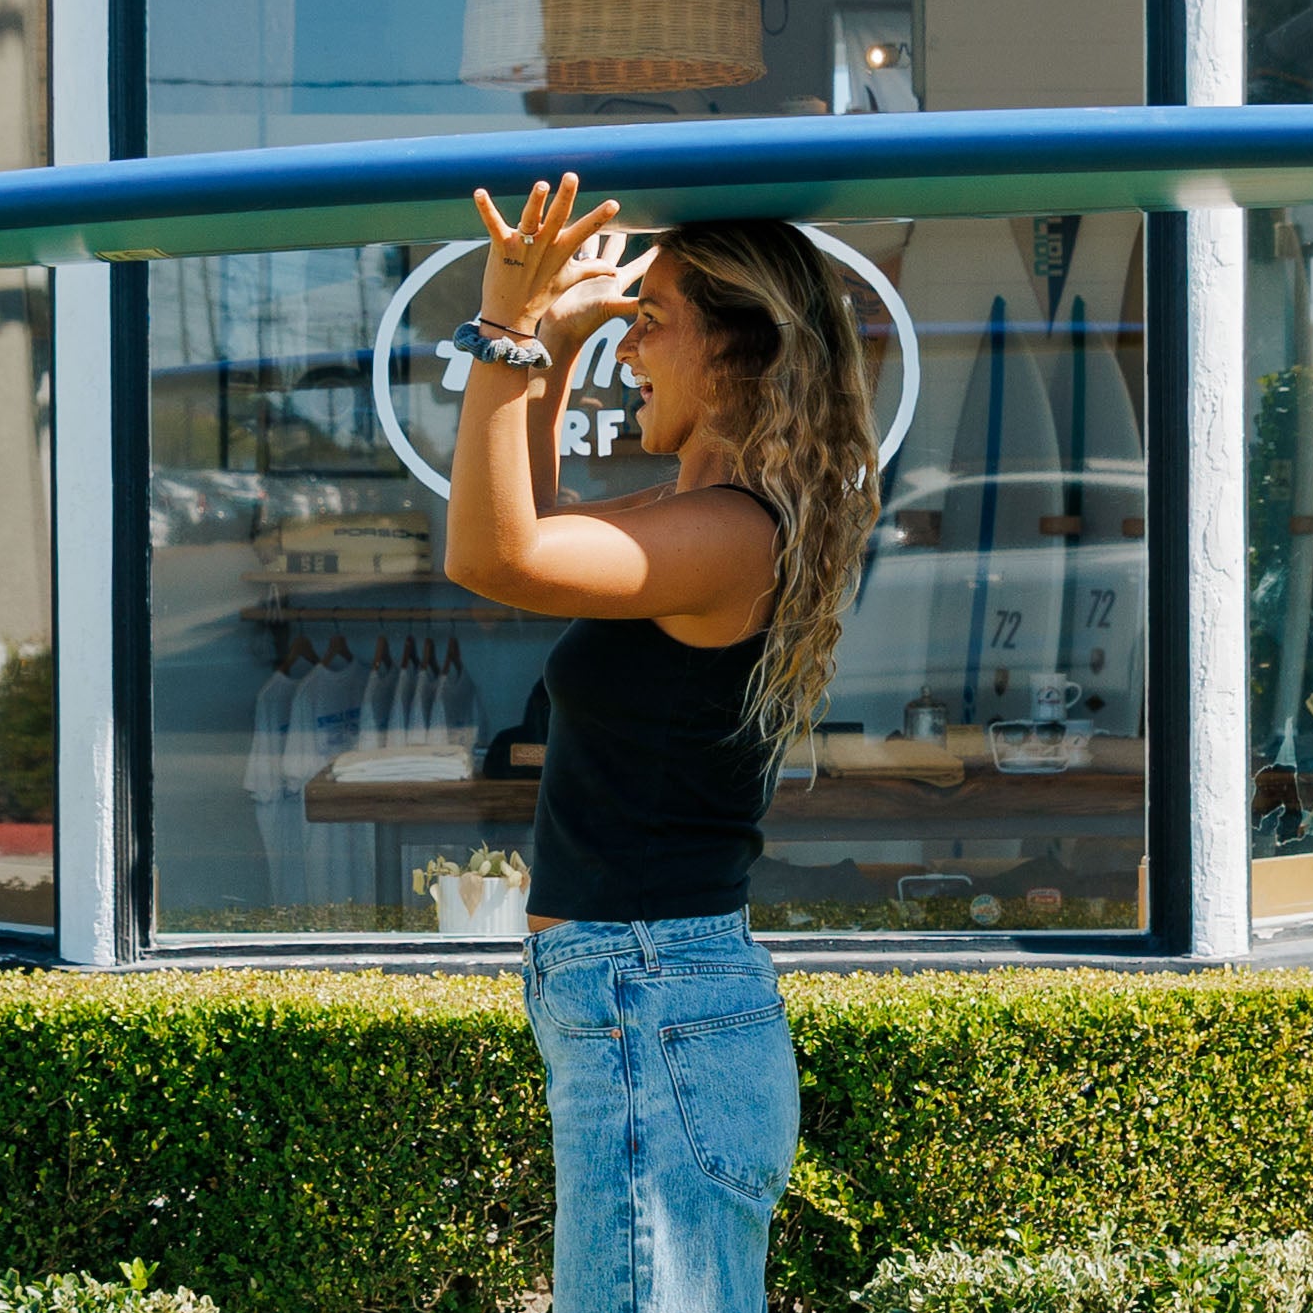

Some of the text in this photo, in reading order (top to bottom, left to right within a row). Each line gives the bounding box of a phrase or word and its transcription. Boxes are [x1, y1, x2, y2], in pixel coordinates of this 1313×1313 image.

[559, 409, 625, 457] RF
[990, 609, 1023, 650] 72
[1085, 589, 1117, 629] 72
